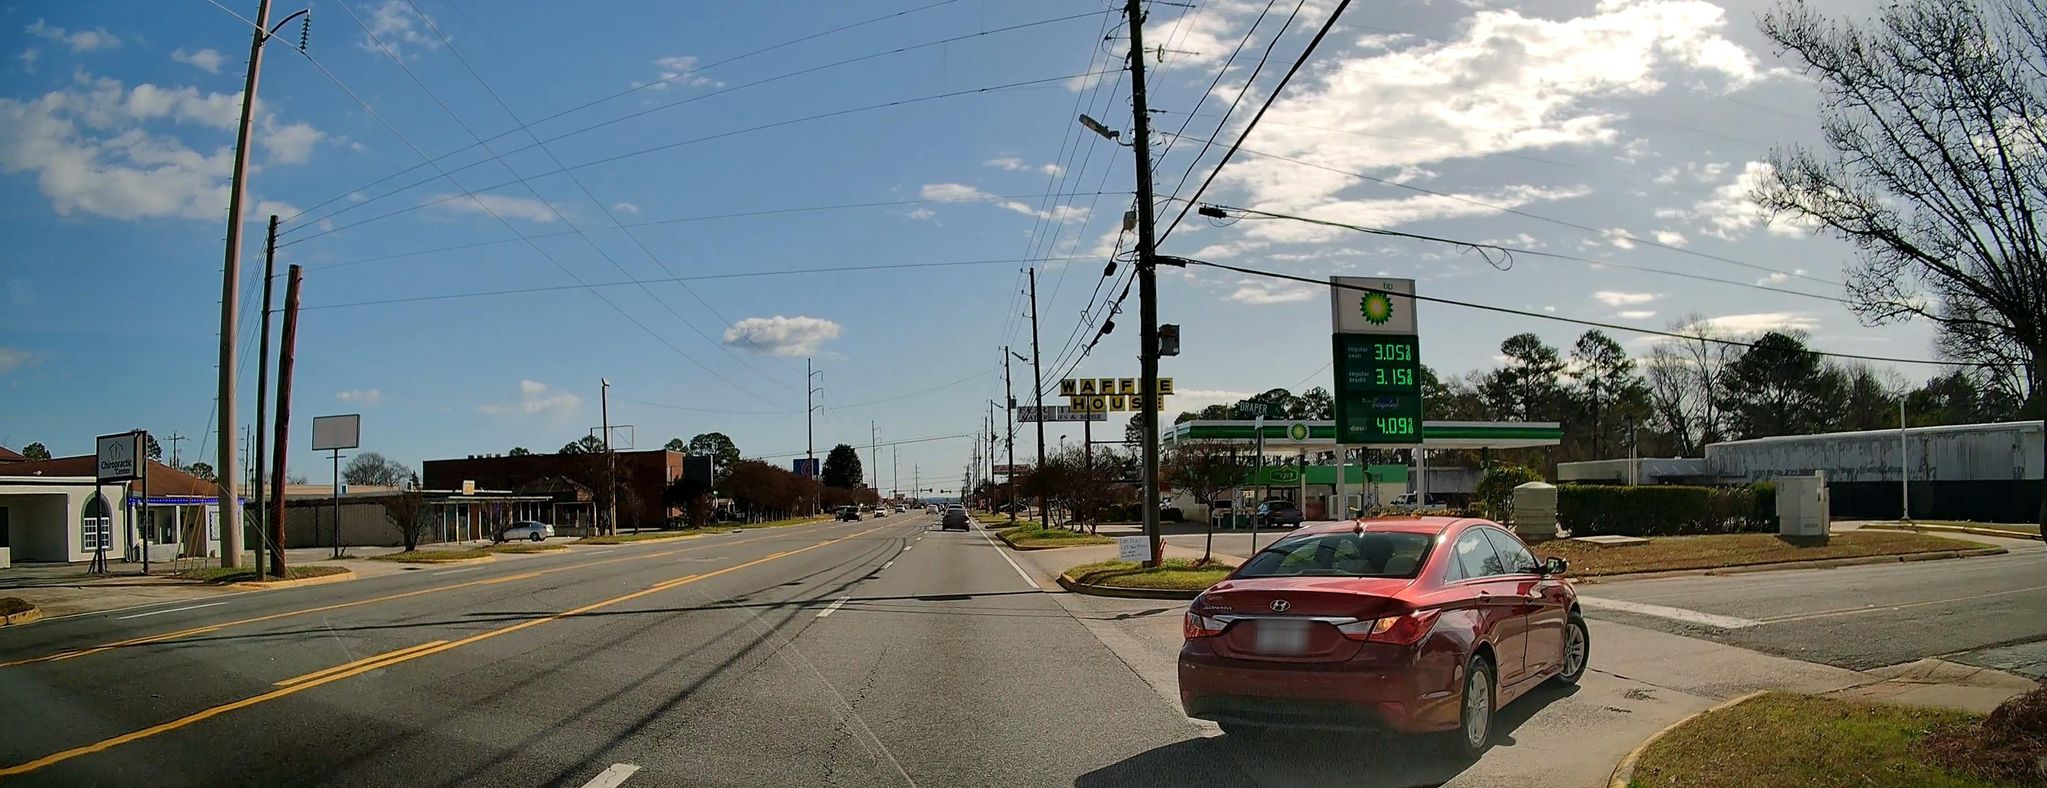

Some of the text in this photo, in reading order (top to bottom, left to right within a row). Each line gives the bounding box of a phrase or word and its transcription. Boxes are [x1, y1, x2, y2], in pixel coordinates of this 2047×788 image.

[1062, 380, 1171, 392] WAFFE
[1239, 401, 1268, 415] DRAPER
[101, 458, 132, 469] Chiropractic
